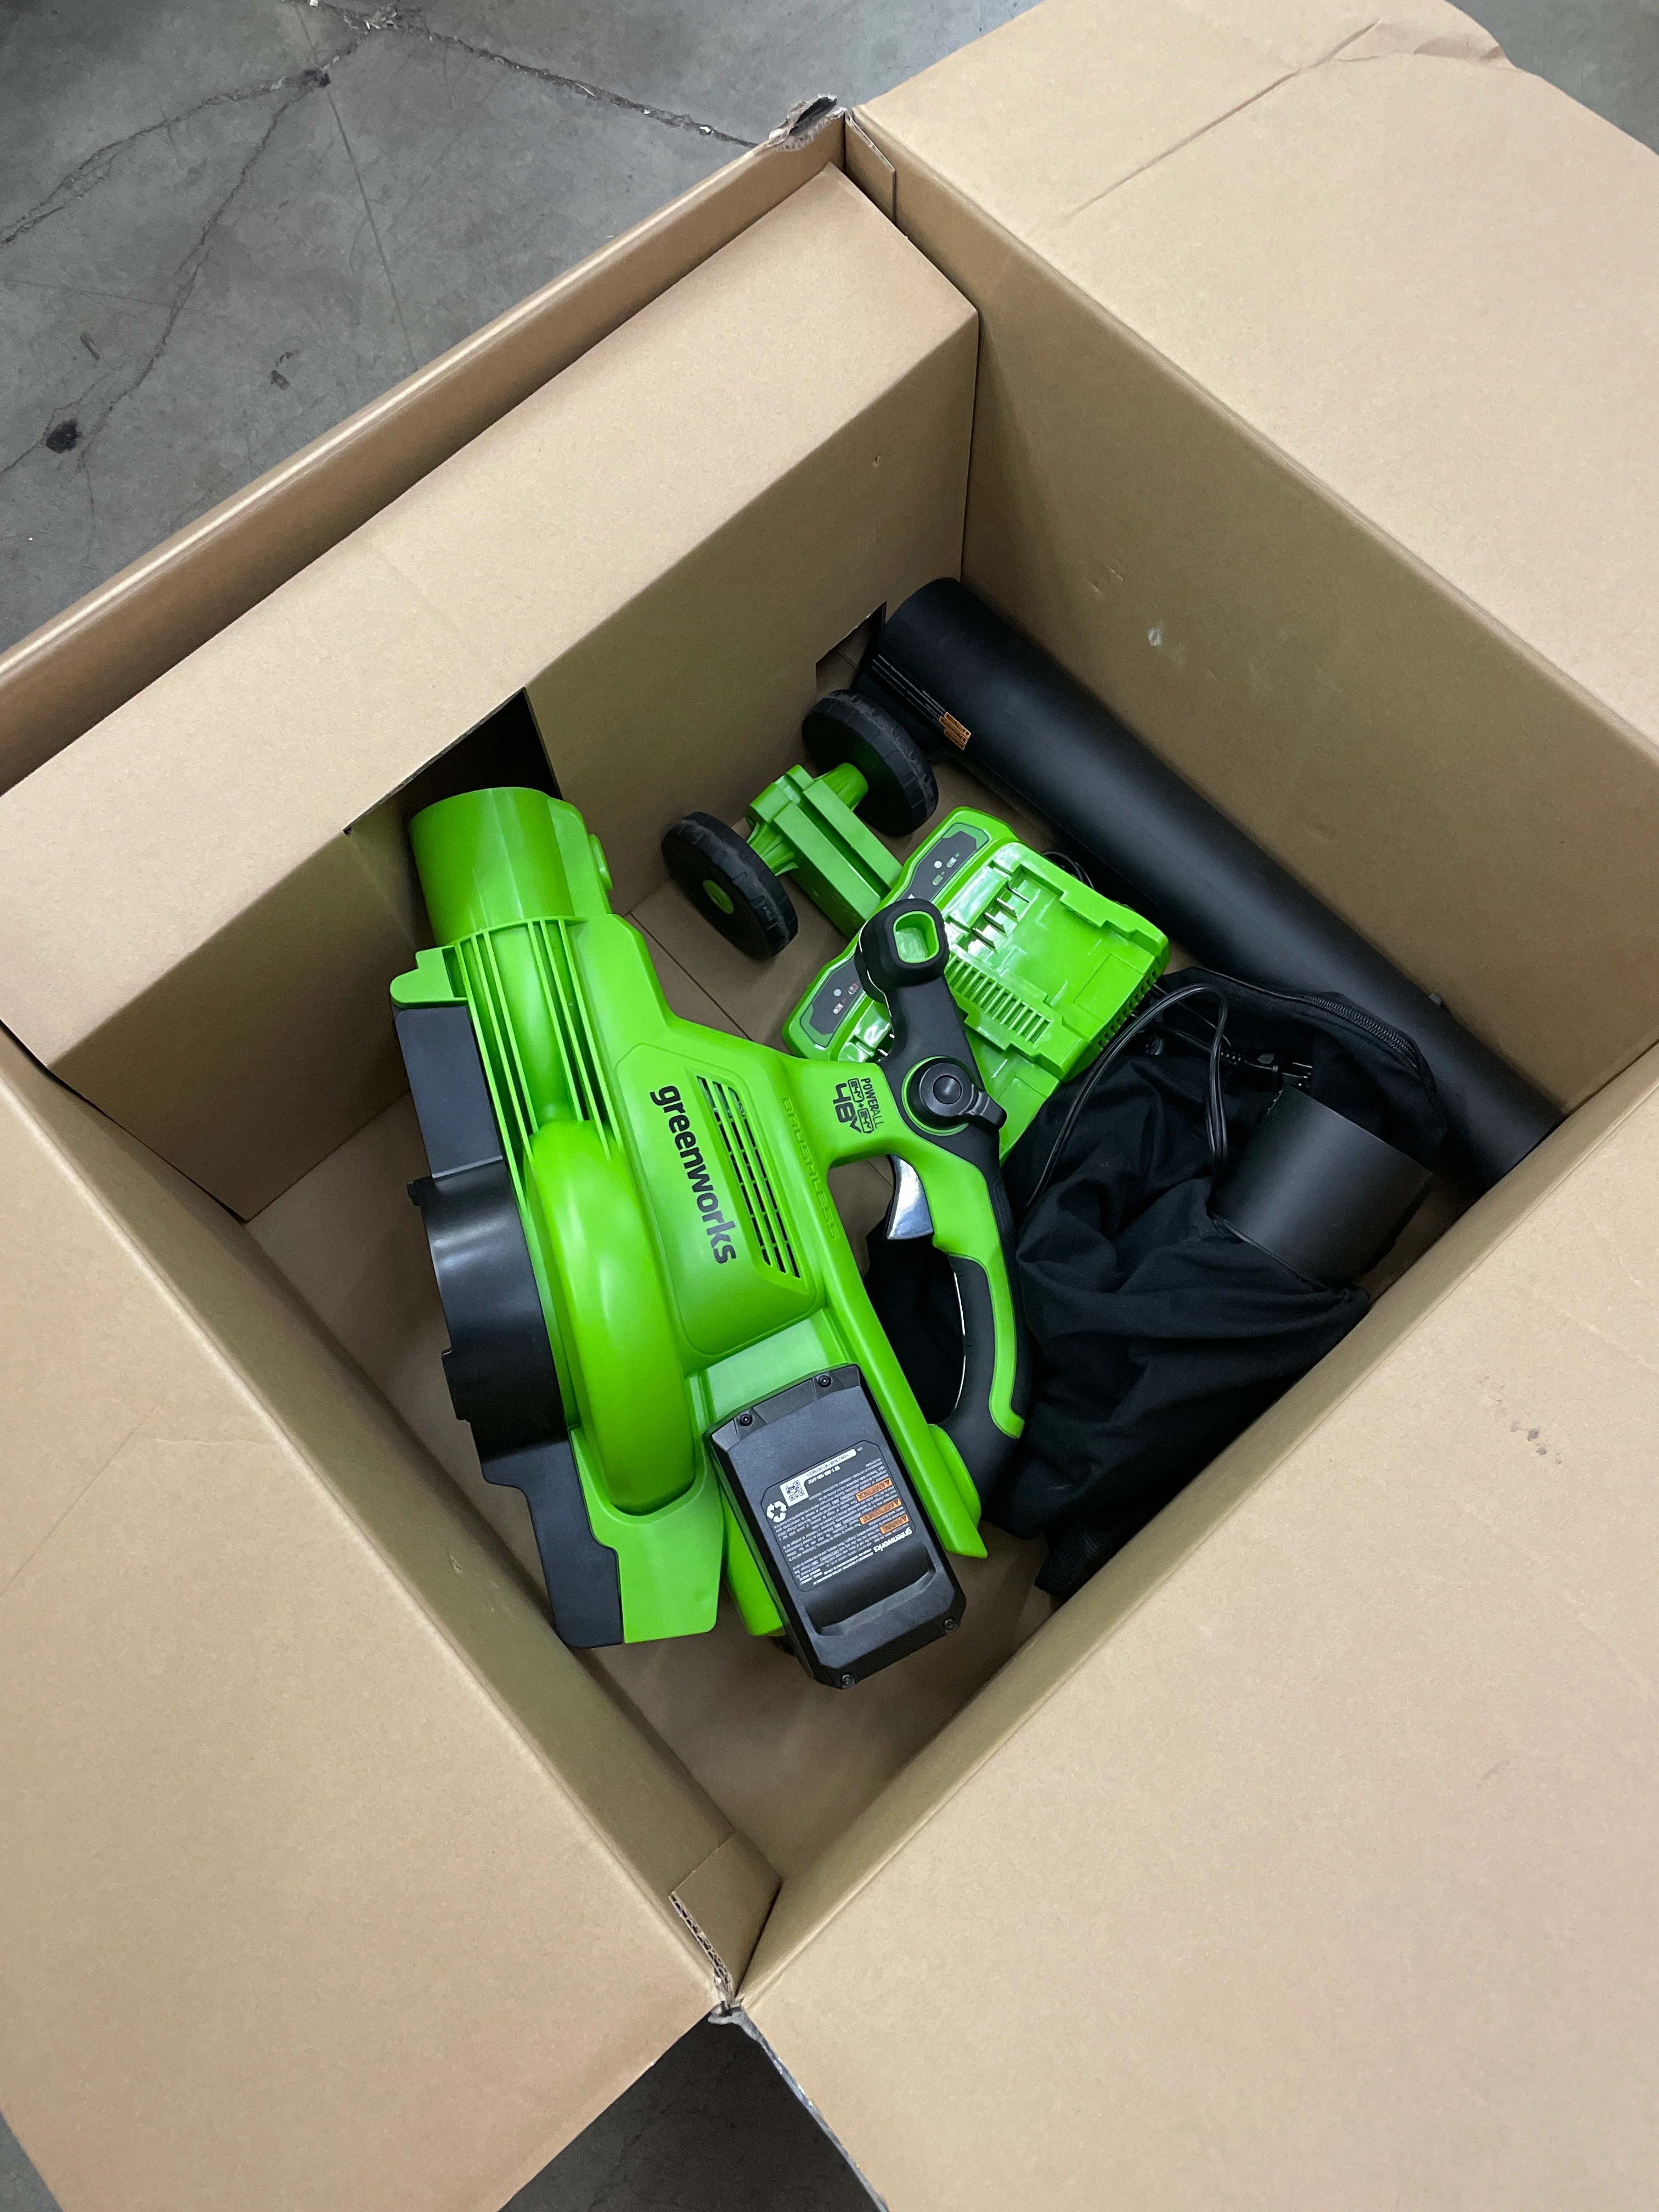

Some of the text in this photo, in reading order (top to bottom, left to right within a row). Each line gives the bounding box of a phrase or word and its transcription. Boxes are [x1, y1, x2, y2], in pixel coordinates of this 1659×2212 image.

[833, 1083, 861, 1133] 48V
[861, 1077, 884, 1128] POWERALL
[650, 1086, 737, 1264] greenworks
[782, 1098, 839, 1240] BRUSHLESS
[873, 1527, 912, 1552] greenworks
[882, 1516, 903, 1532] WARNING
